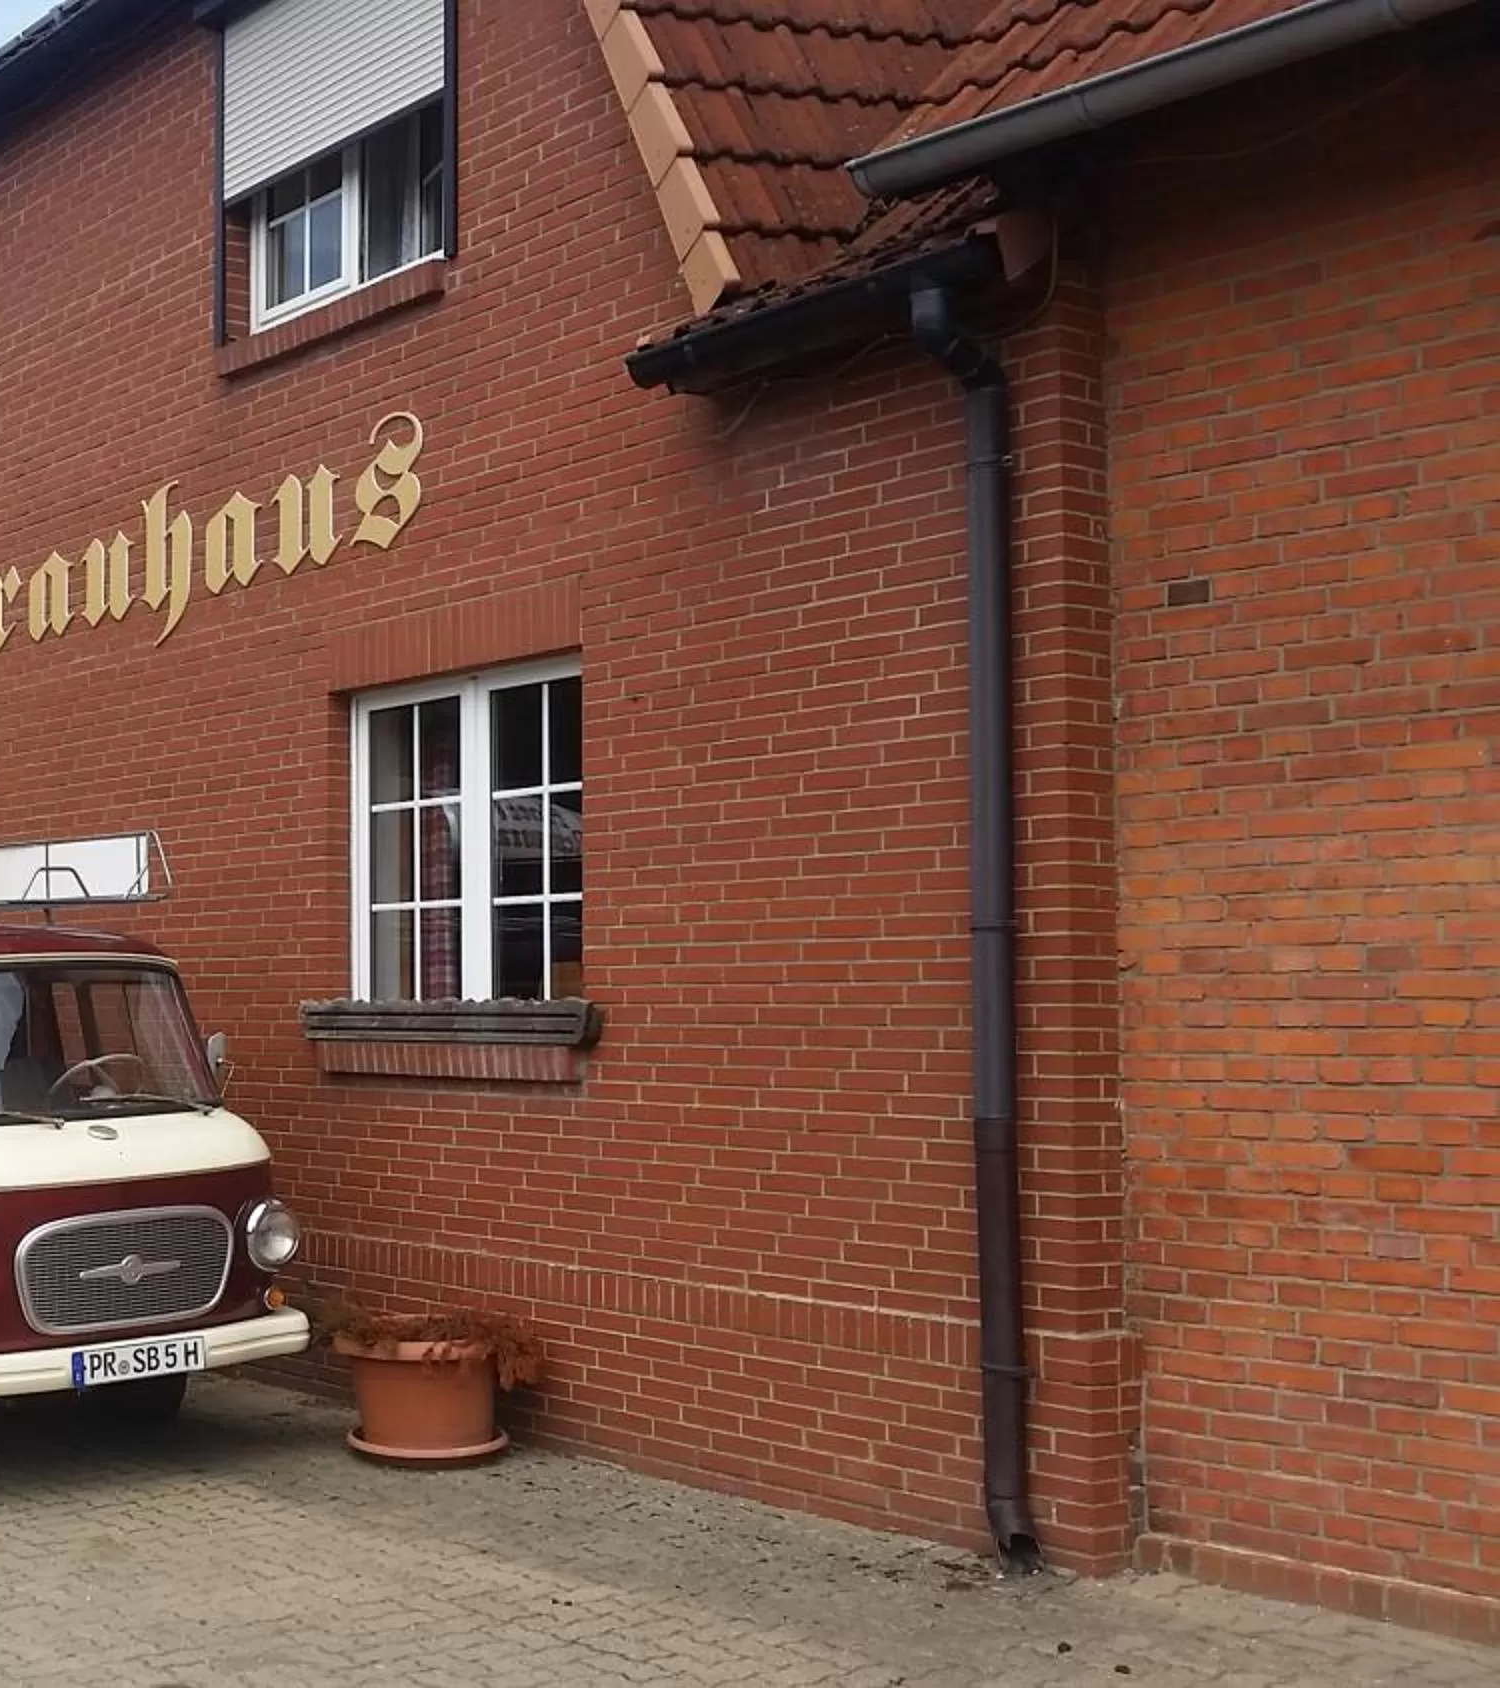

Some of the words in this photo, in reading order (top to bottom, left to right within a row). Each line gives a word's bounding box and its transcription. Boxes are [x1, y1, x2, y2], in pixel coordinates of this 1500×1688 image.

[89, 1351, 117, 1379] PR
[133, 1345, 160, 1373] SB
[165, 1343, 177, 1368] 5
[183, 1341, 199, 1366] H
